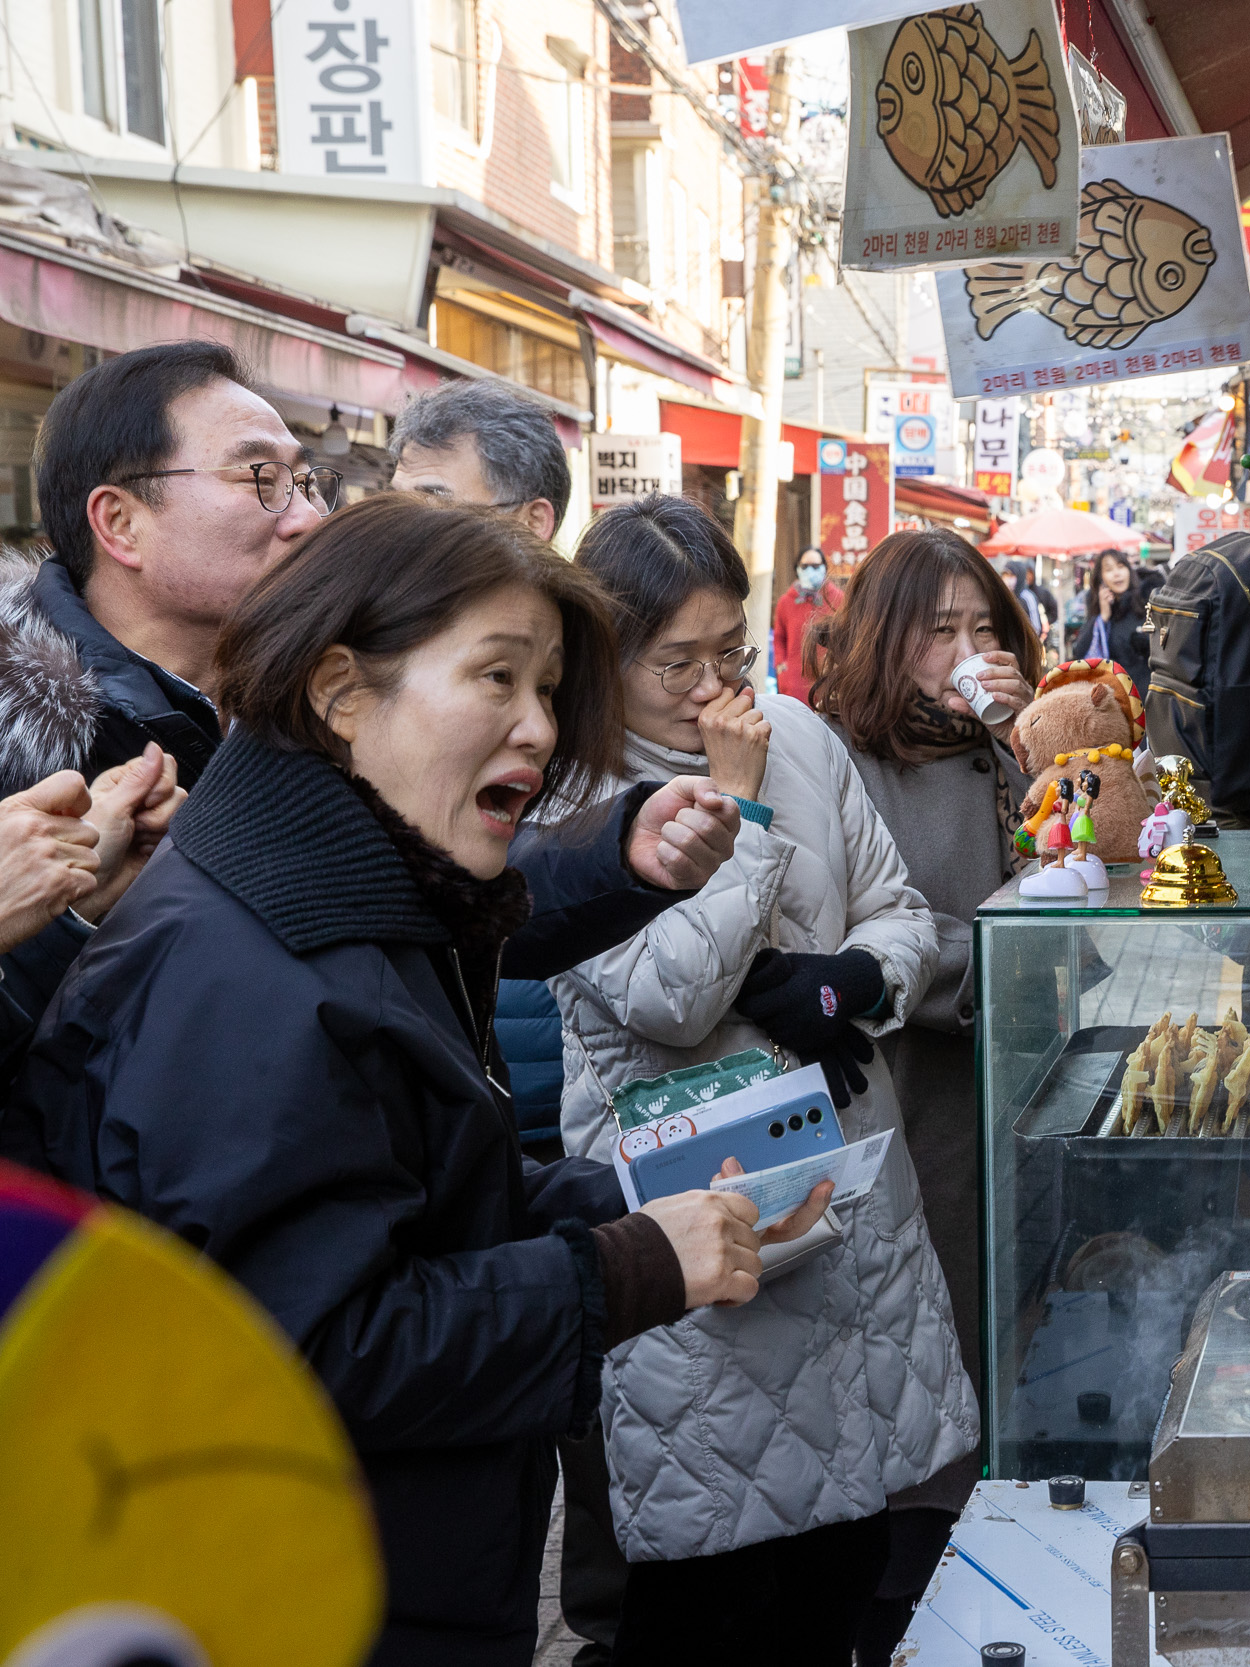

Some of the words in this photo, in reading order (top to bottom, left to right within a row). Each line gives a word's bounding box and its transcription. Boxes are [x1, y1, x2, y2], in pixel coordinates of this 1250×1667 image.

[863, 232, 898, 259] 2마리
[904, 230, 929, 255] 천원
[936, 228, 969, 252] 2마리
[974, 225, 997, 249] 천원
[1000, 223, 1032, 247] 2마리
[1037, 221, 1061, 245] 천원
[982, 369, 1027, 392] 2마리
[1032, 365, 1067, 387] 천원
[1074, 358, 1119, 381] 2마리
[1124, 353, 1157, 375] 천원
[1161, 347, 1204, 370] 2마리
[1210, 342, 1243, 362] 천원
[598, 451, 636, 469] 벽지
[1026, 1609, 1066, 1634] STEEL
